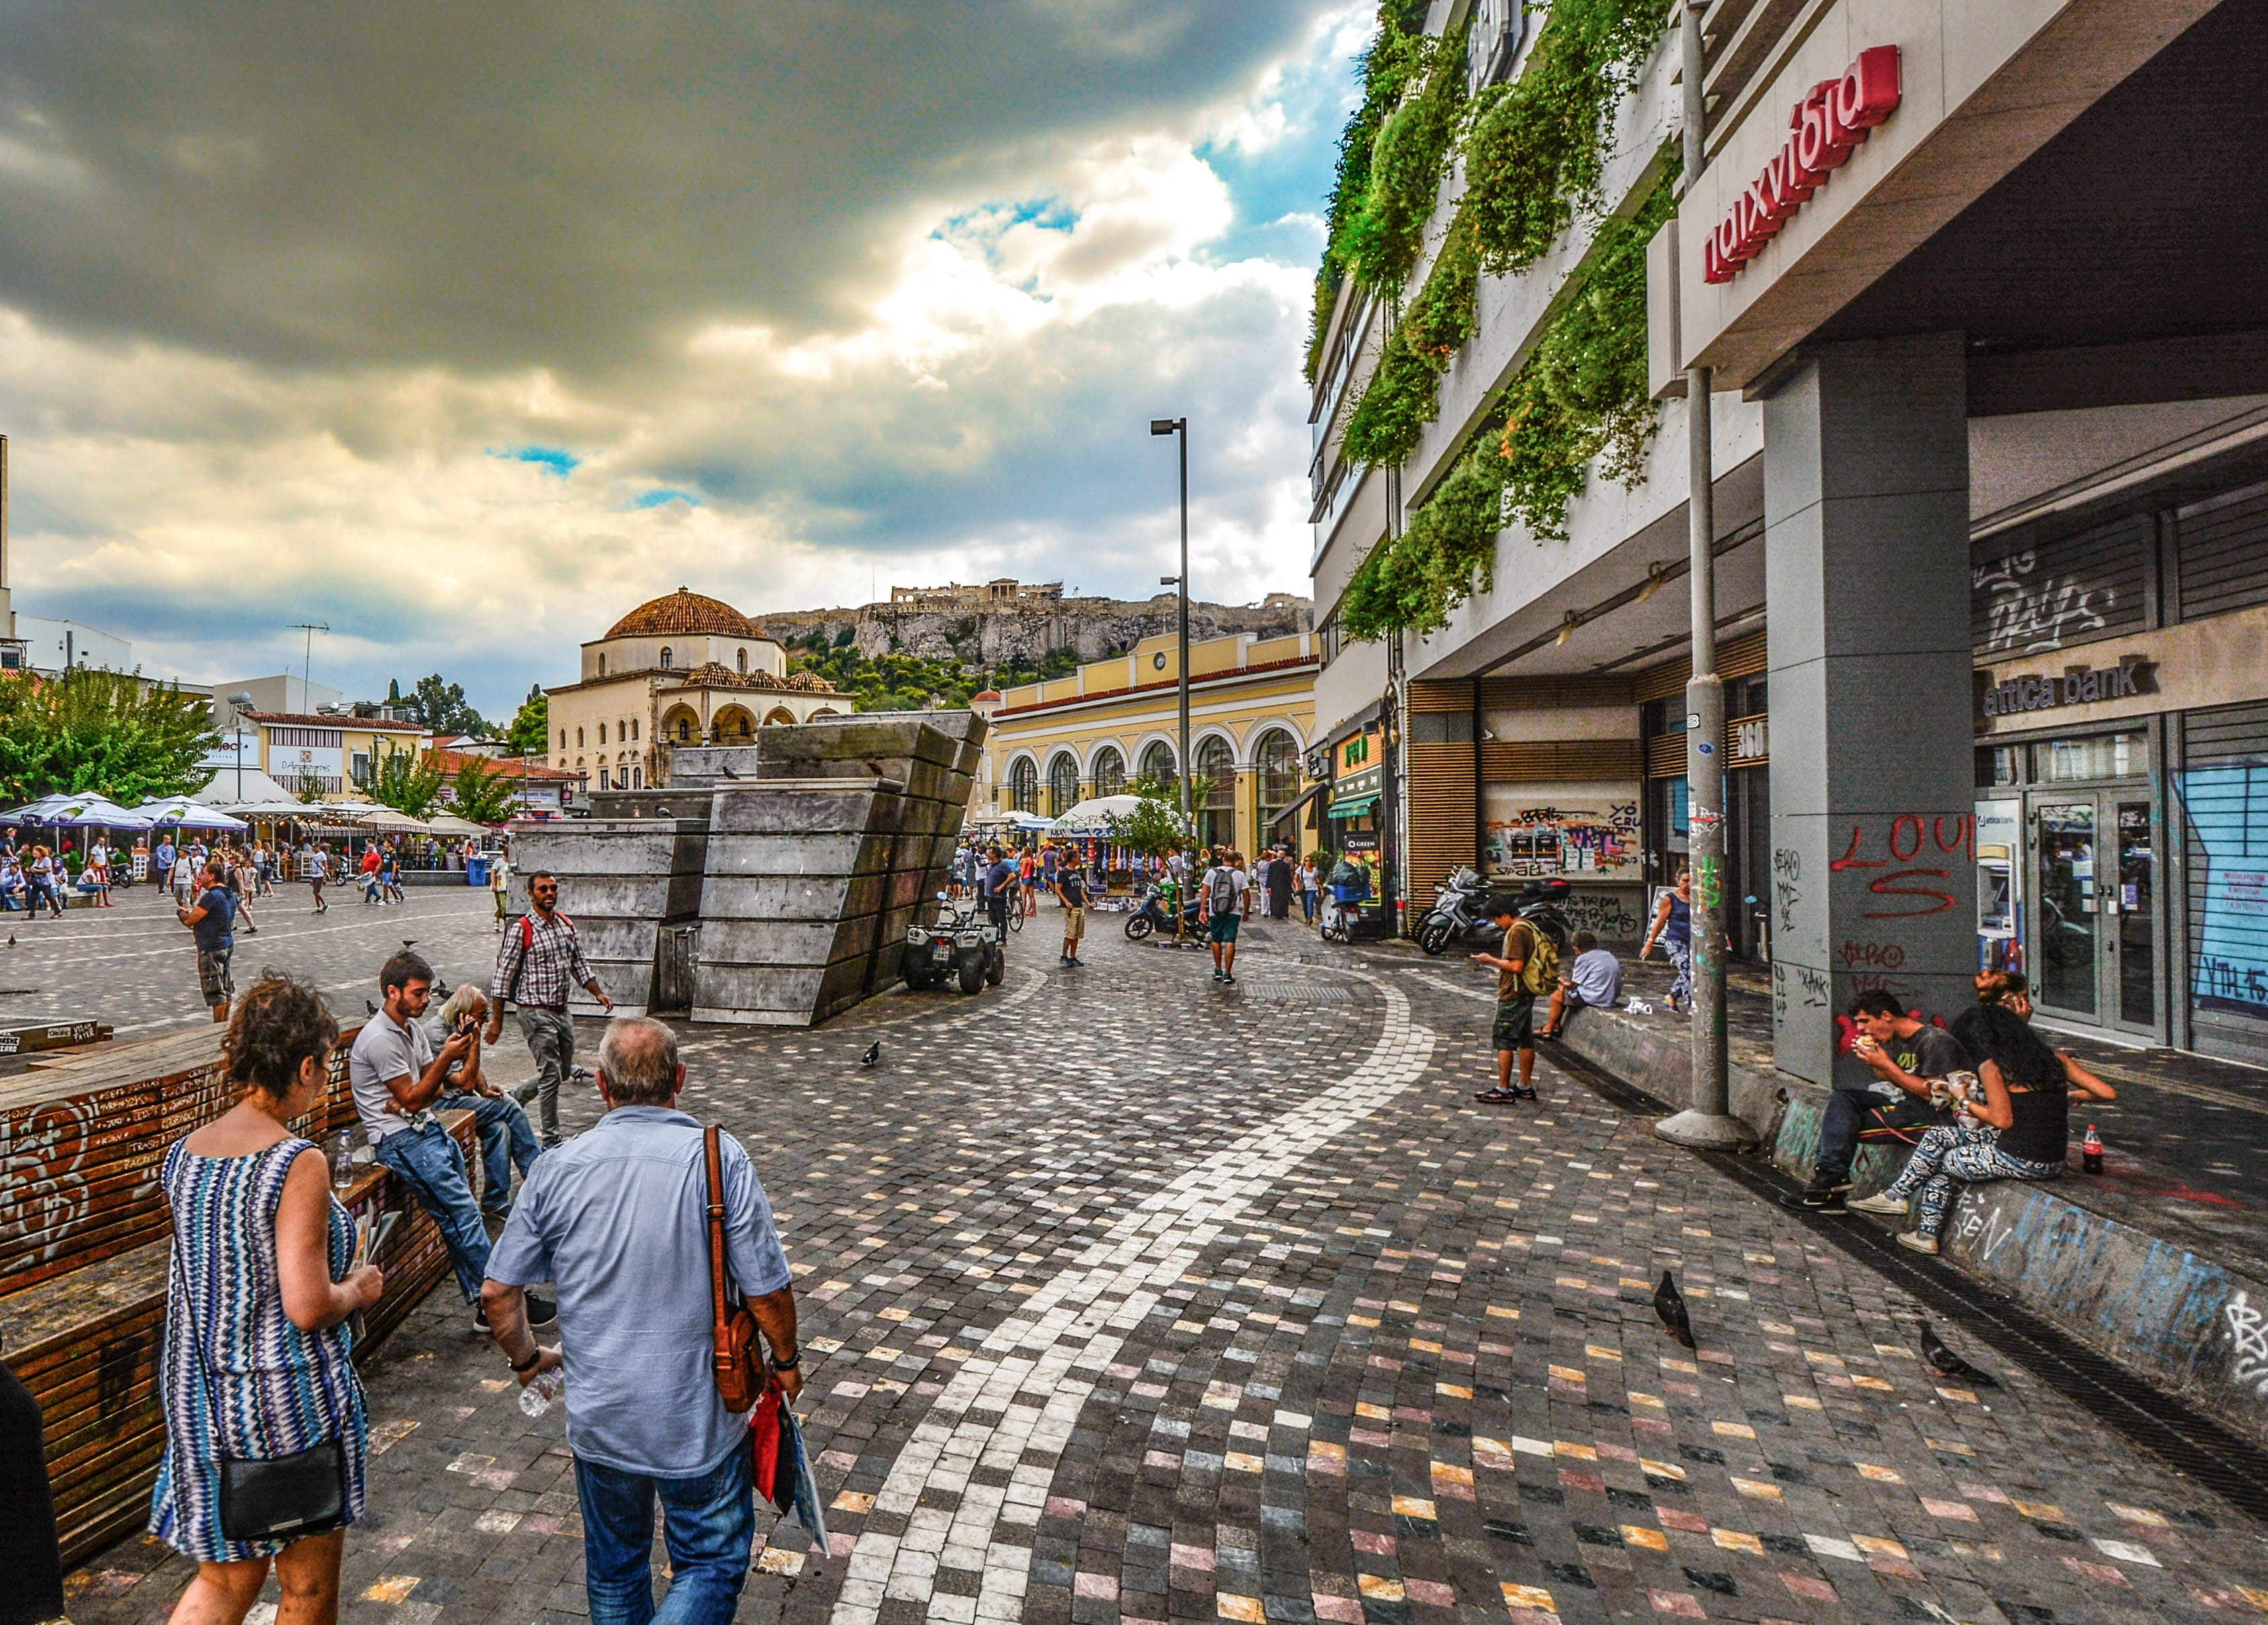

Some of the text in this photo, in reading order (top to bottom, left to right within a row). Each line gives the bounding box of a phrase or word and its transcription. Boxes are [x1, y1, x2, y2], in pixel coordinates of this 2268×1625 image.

[1983, 662, 2138, 716] attica bank
[1737, 721, 1764, 758] 360
